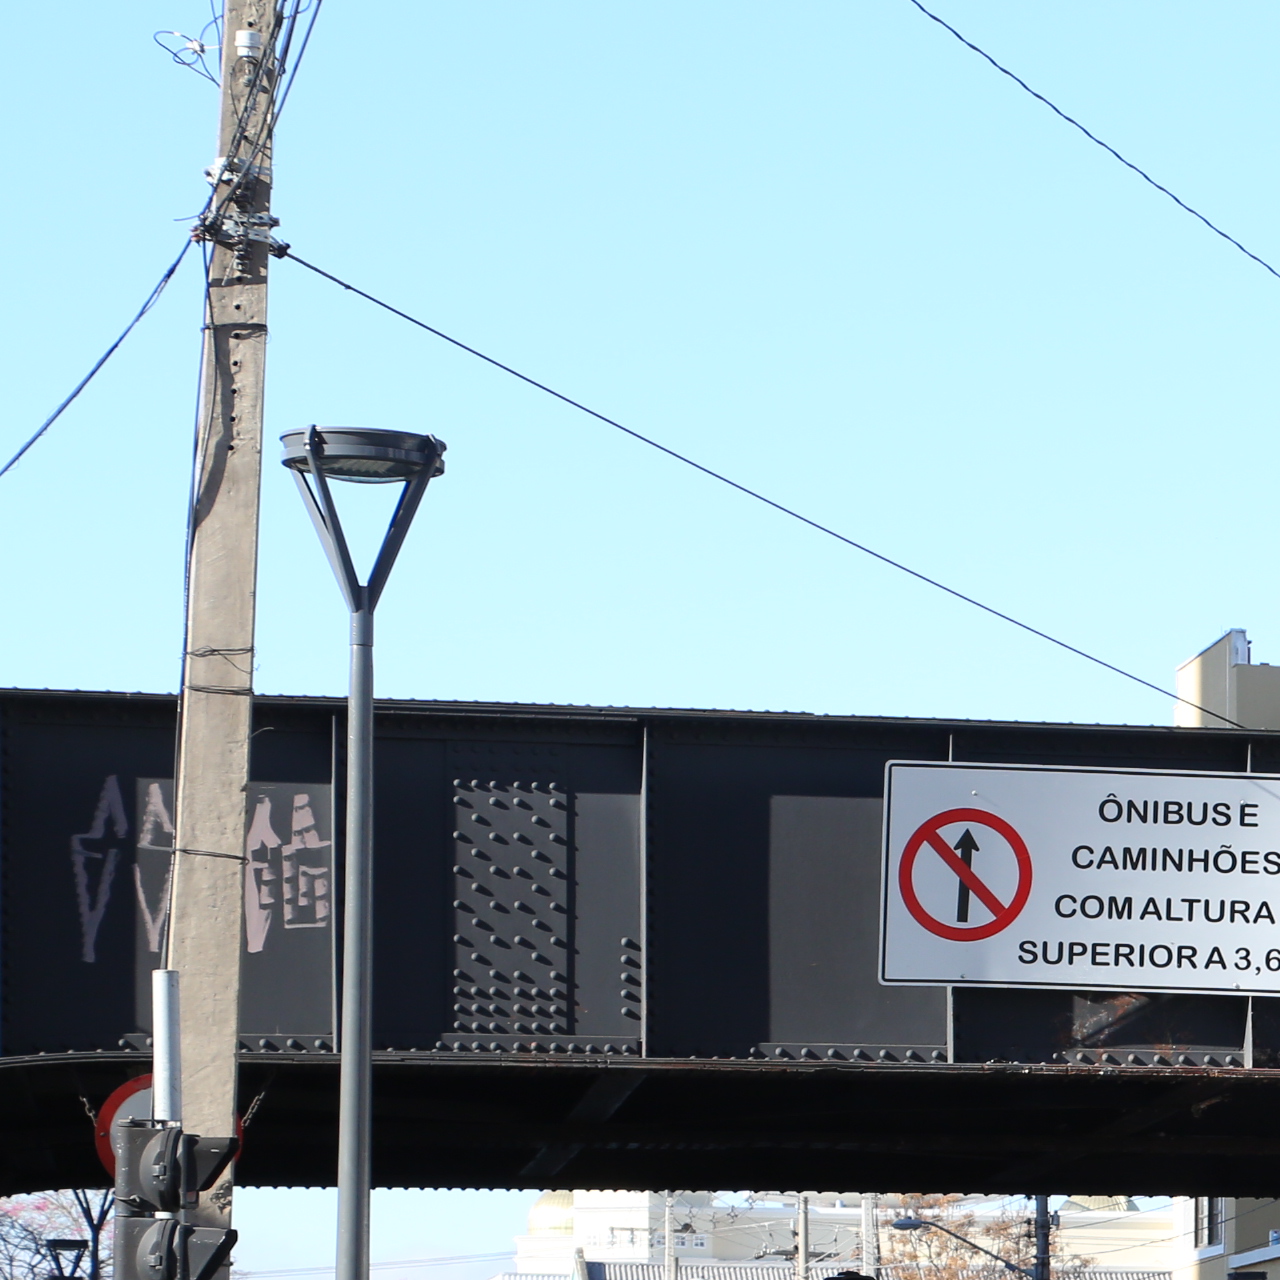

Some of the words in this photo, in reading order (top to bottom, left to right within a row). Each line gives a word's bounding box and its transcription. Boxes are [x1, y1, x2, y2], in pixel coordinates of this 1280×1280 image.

[1098, 792, 1231, 828] ÔNIBUS
[1240, 803, 1259, 828] E
[1055, 893, 1131, 921] COM
[1139, 896, 1276, 925] ALTURA
[1017, 939, 1198, 970] SUPERIOR
[1204, 943, 1228, 970] A
